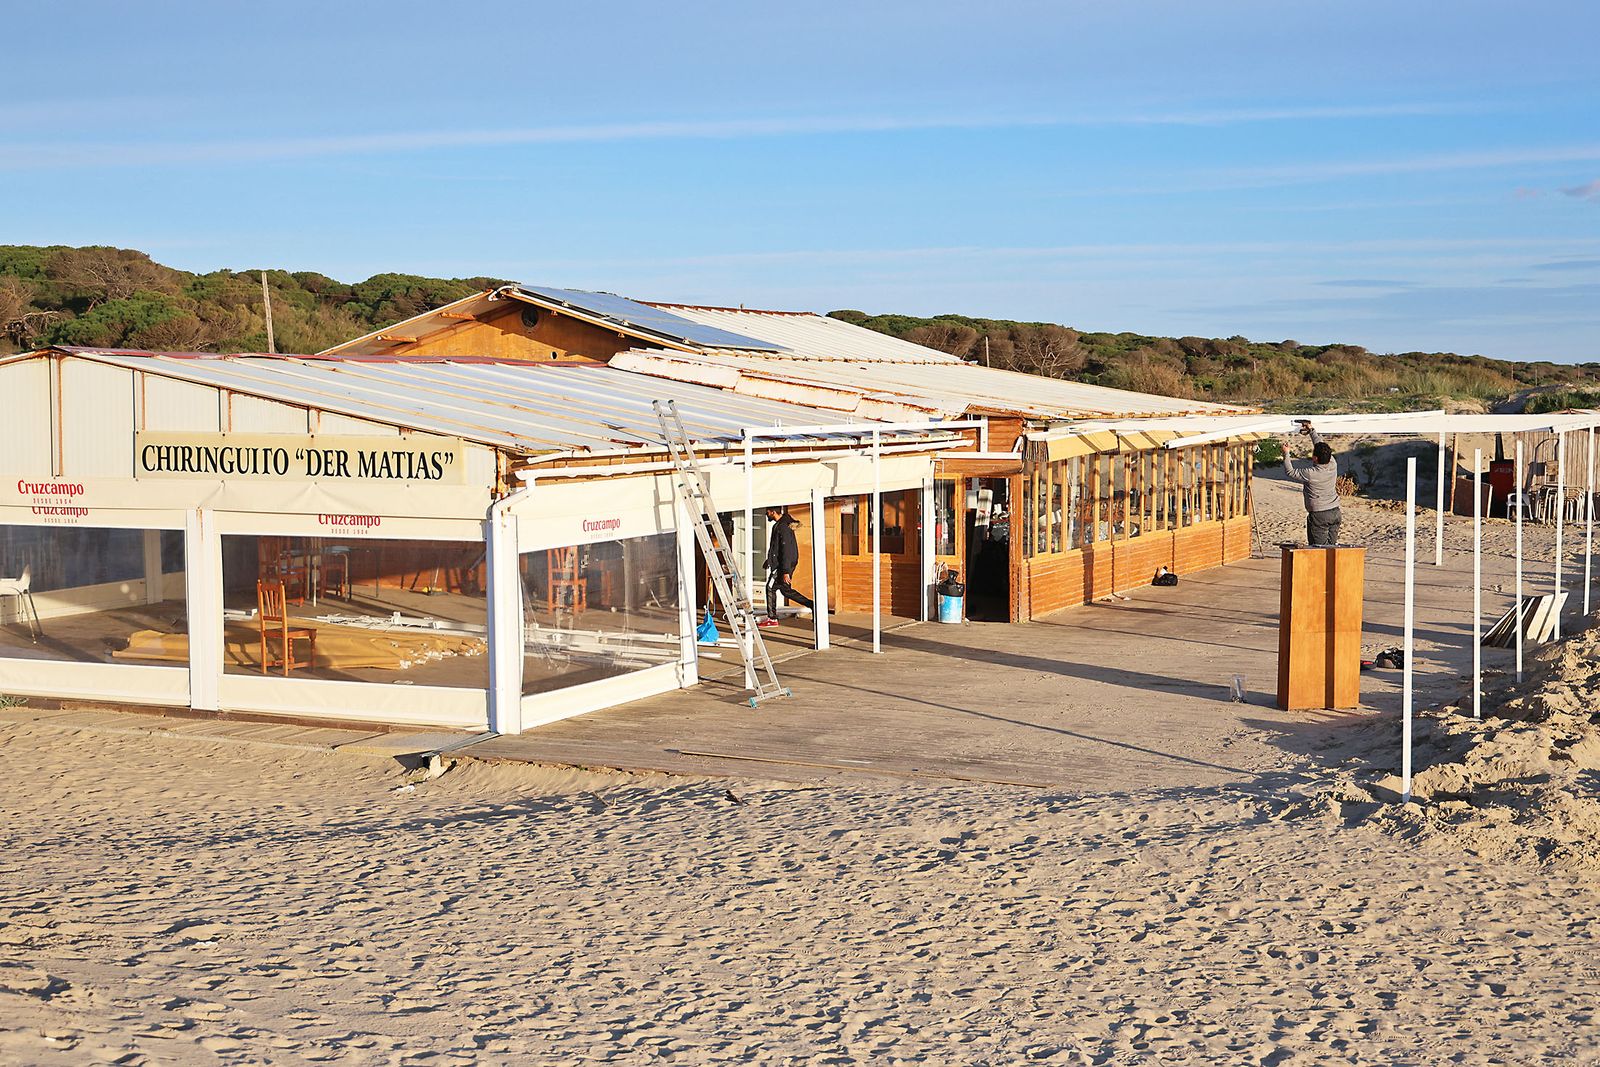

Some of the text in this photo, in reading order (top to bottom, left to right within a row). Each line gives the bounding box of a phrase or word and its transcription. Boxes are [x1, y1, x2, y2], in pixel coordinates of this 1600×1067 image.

[142, 444, 454, 480] CHIRINGUITO “DER MATIAS”
[17, 479, 84, 498] Cruzcampo
[318, 513, 381, 528] Cruzcampo
[582, 518, 621, 533] Cruzcampo
